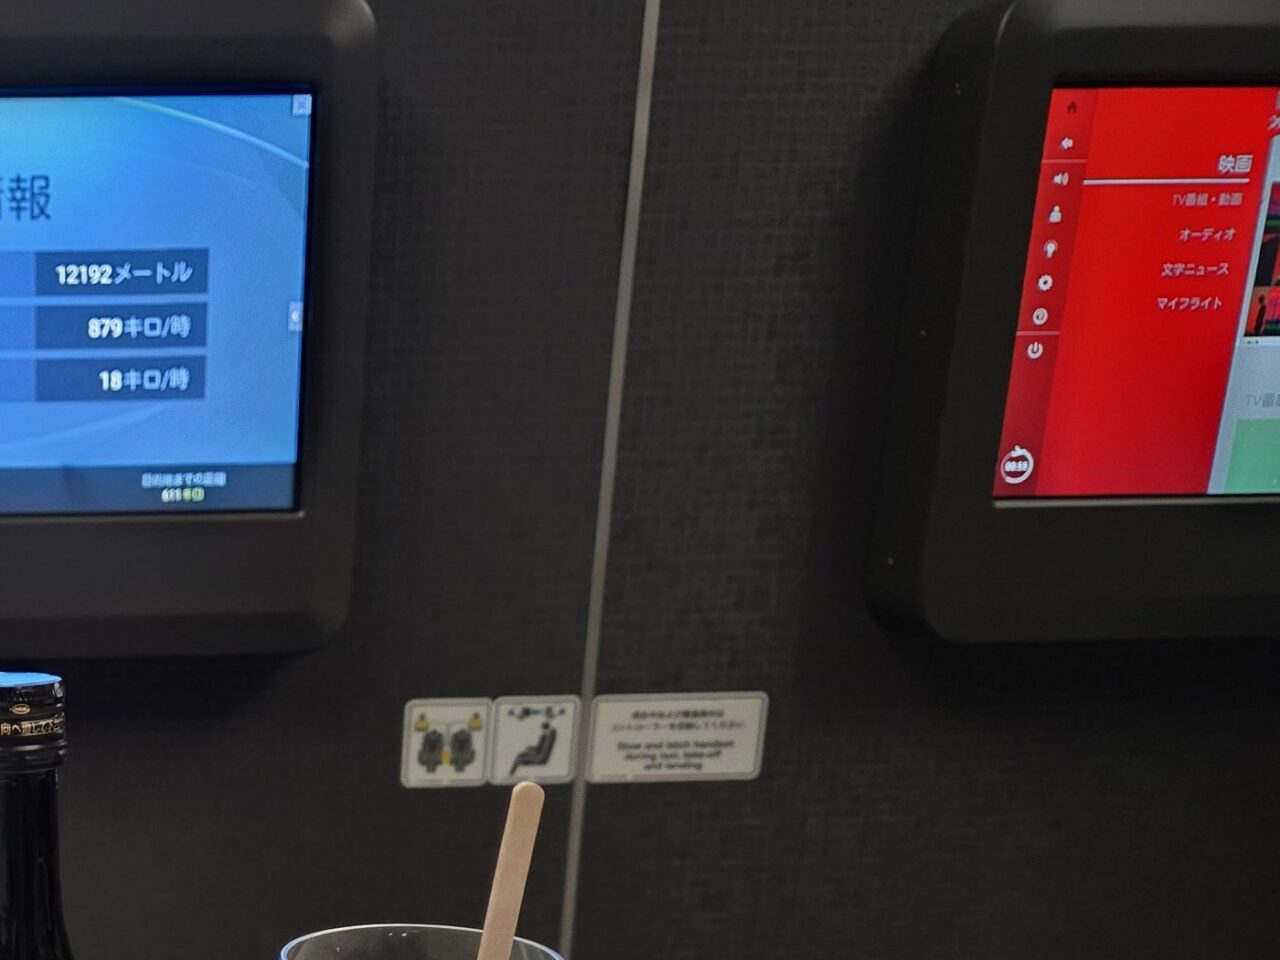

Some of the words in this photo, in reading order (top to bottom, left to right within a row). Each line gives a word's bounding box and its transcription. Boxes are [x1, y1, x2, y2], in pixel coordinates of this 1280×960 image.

[1216, 154, 1253, 174] 映画
[1178, 227, 1236, 242] オーディオ
[55, 263, 193, 286] 12192メートル
[1161, 262, 1229, 277] 文字ニュース
[1156, 296, 1222, 311] マイフライト
